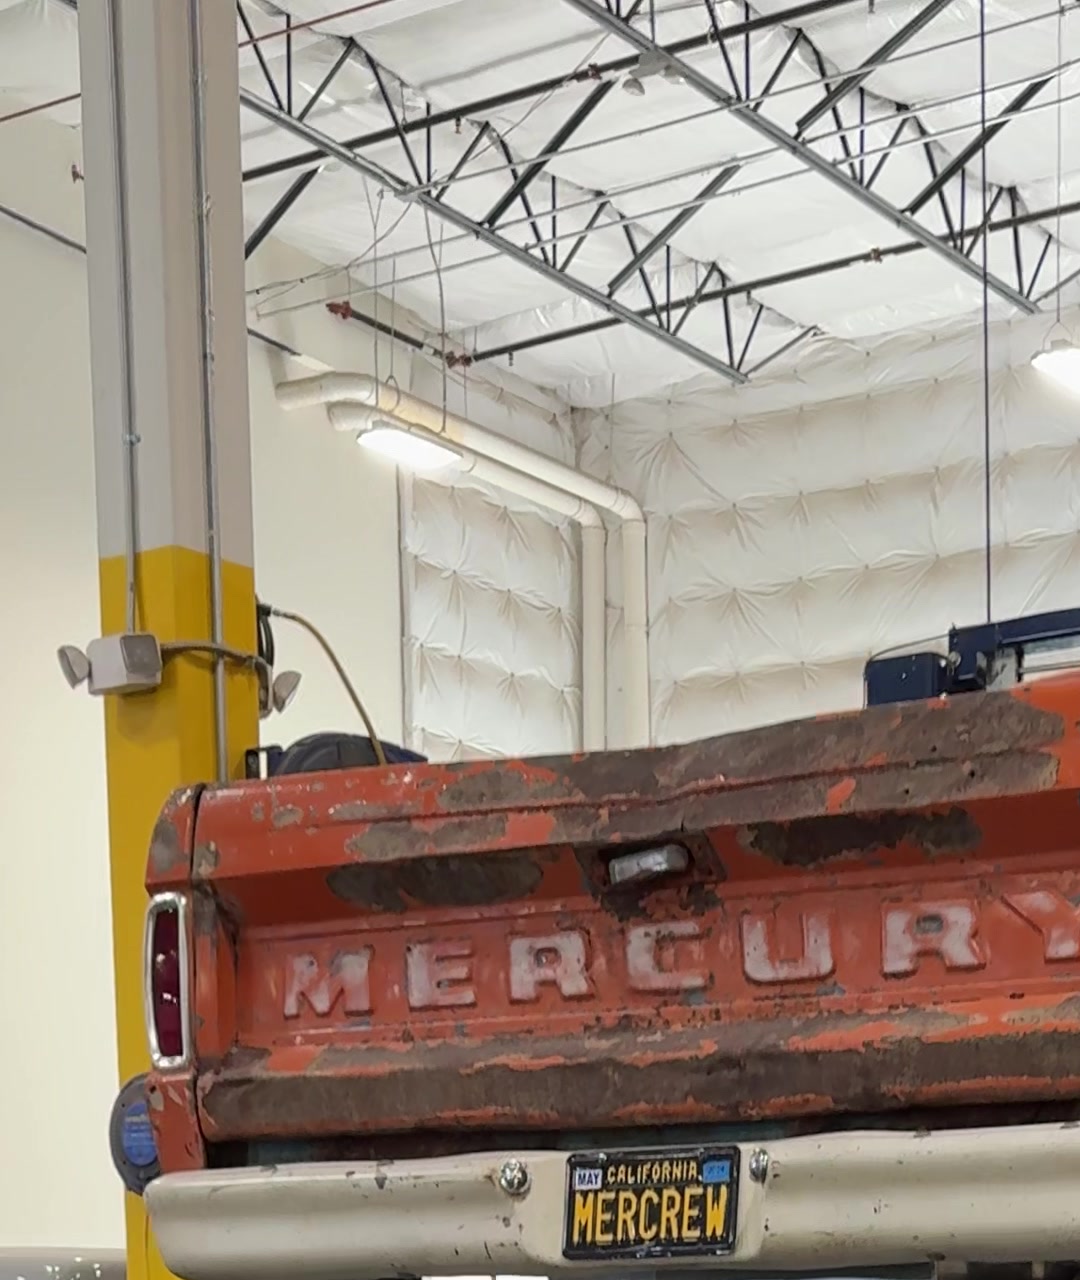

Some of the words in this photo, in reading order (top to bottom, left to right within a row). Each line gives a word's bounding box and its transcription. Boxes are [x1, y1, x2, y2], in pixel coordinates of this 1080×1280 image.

[576, 1170, 601, 1187] MAY
[607, 1161, 697, 1184] CALIFORNIA
[573, 1185, 728, 1246] MERCREW
